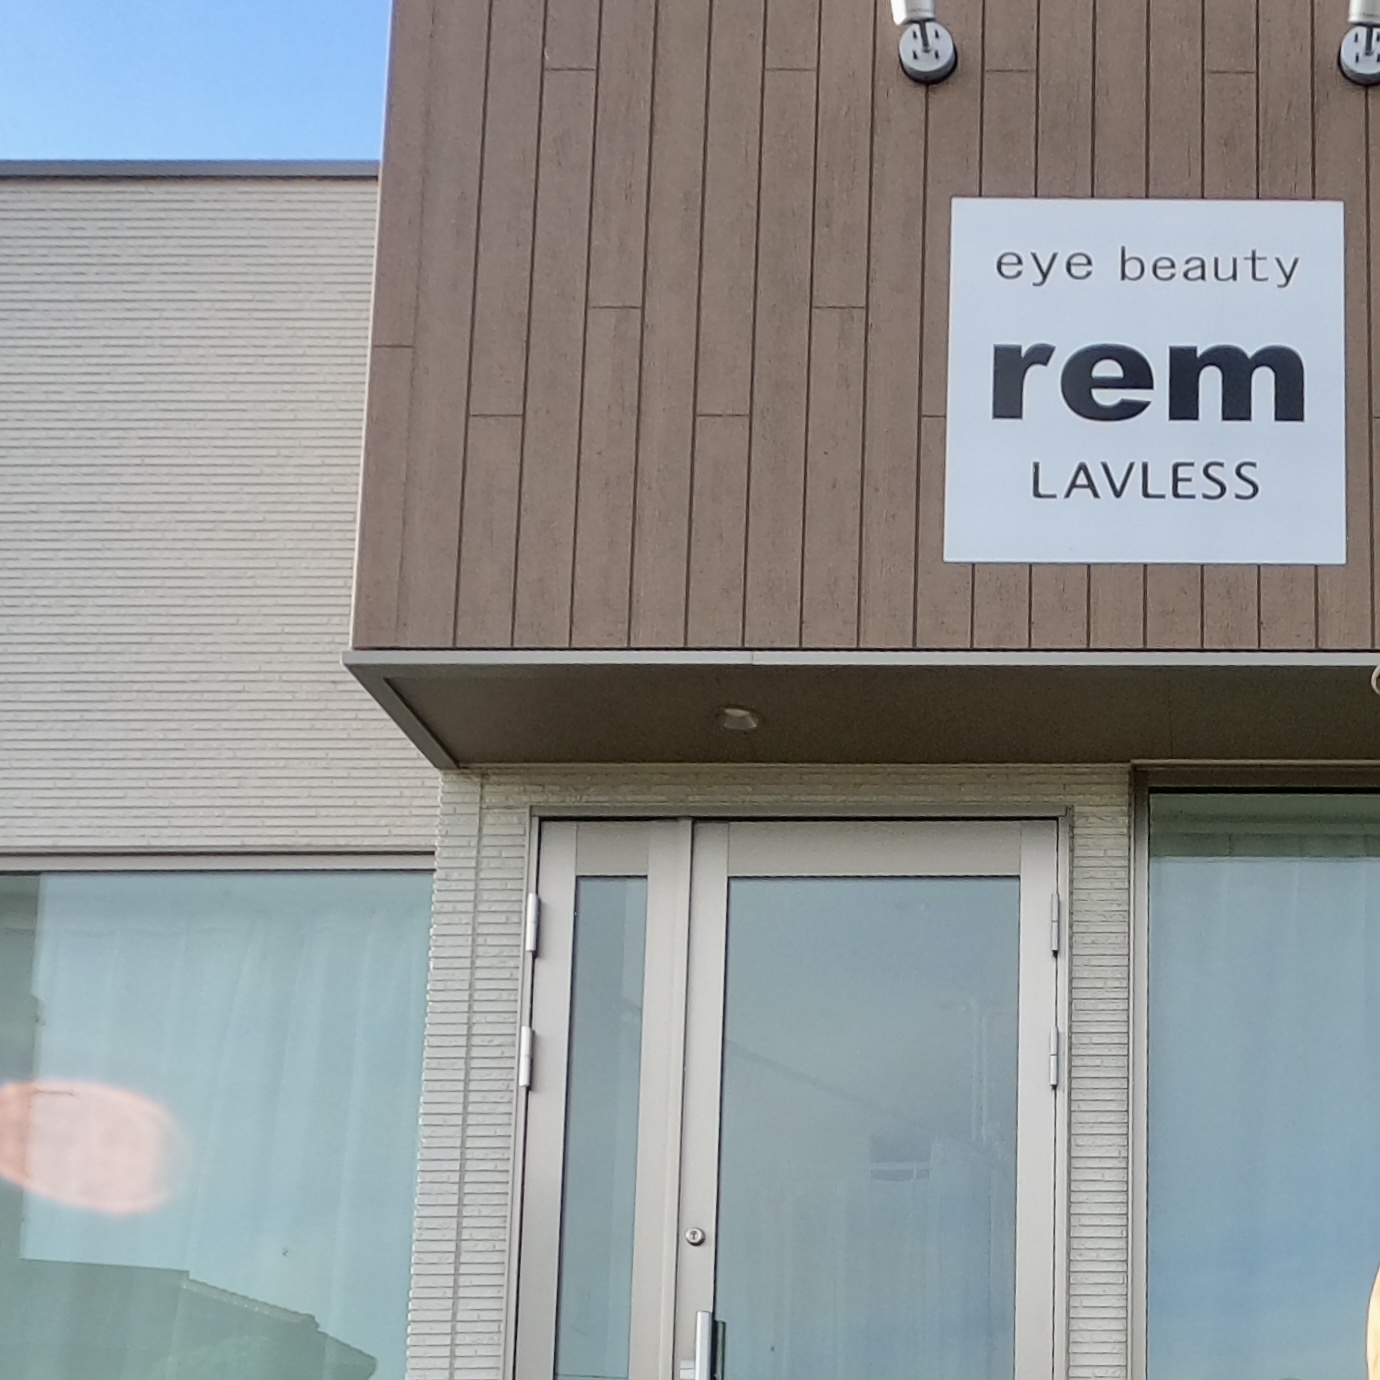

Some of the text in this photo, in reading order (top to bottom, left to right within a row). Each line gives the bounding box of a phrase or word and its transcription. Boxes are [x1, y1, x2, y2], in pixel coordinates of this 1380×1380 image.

[995, 245, 1300, 288] eye beauty
[991, 342, 1306, 422] rem
[1031, 460, 1260, 500] LAVLESS
